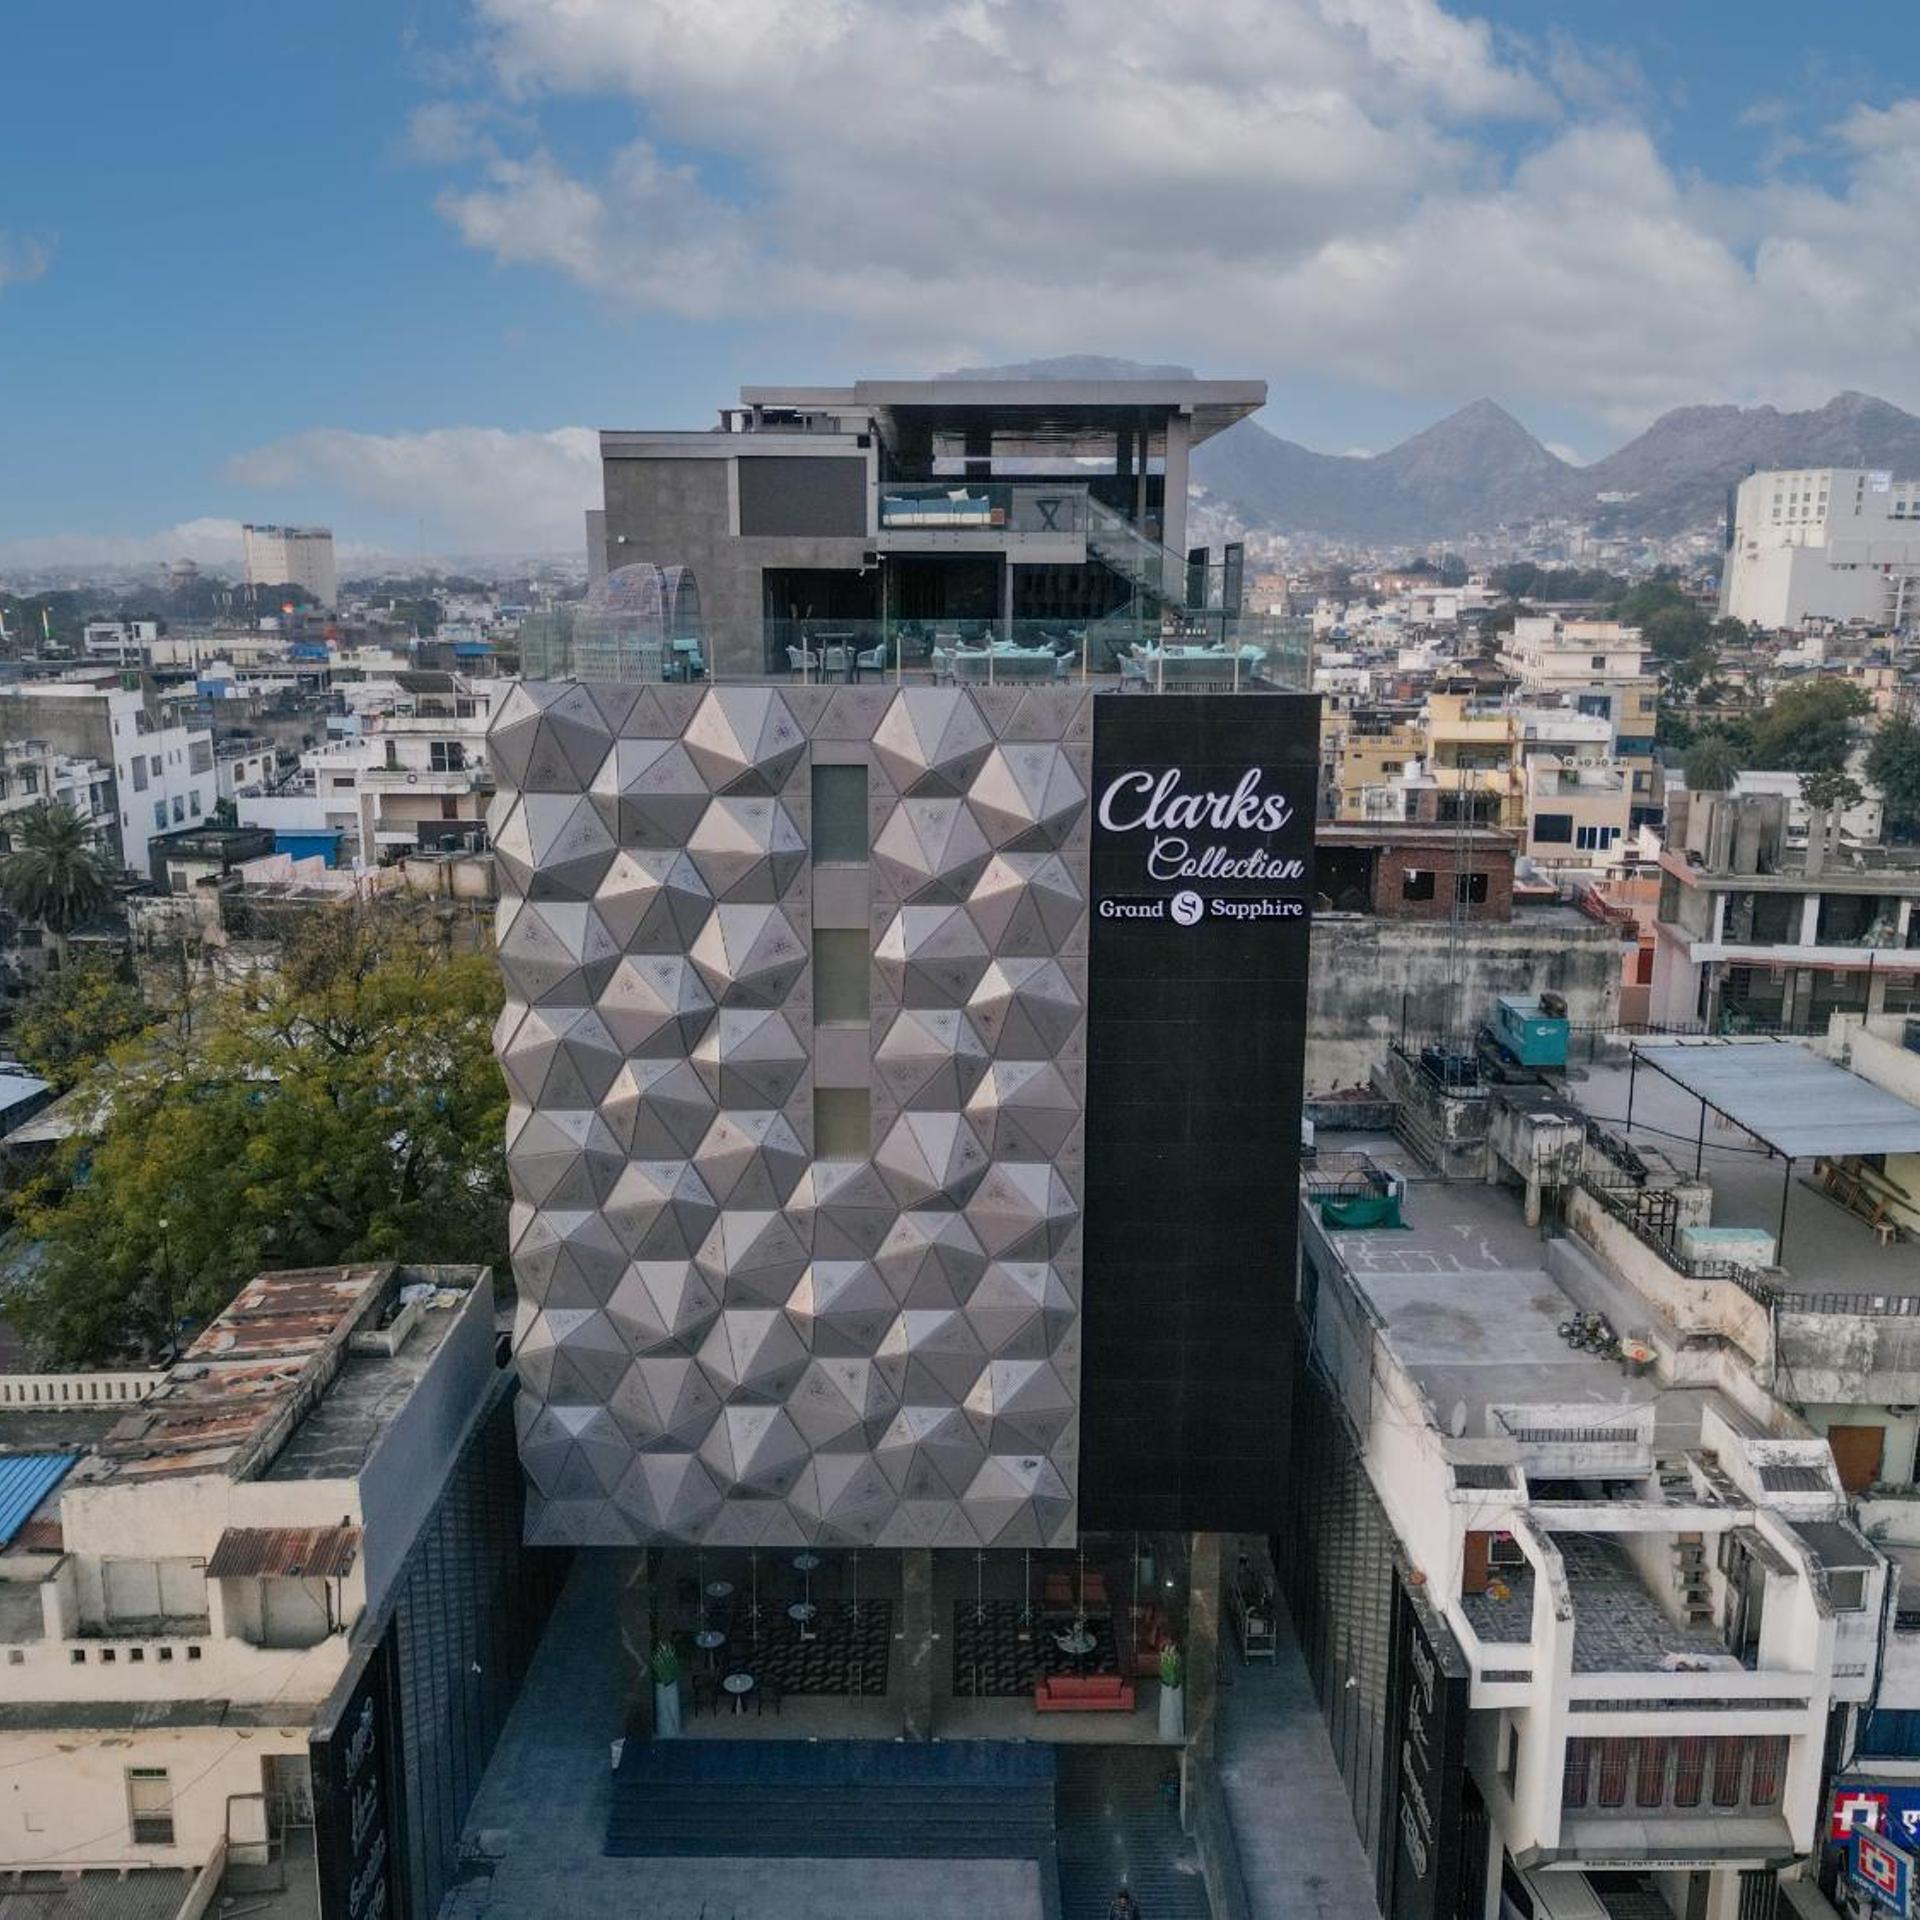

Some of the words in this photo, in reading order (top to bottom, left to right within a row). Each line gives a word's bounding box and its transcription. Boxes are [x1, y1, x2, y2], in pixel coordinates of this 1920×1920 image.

[1098, 767, 1294, 832] Clarks
[1147, 834, 1304, 880] Collection
[1100, 900, 1164, 918] Grand
[1210, 899, 1303, 920] Sapphire
